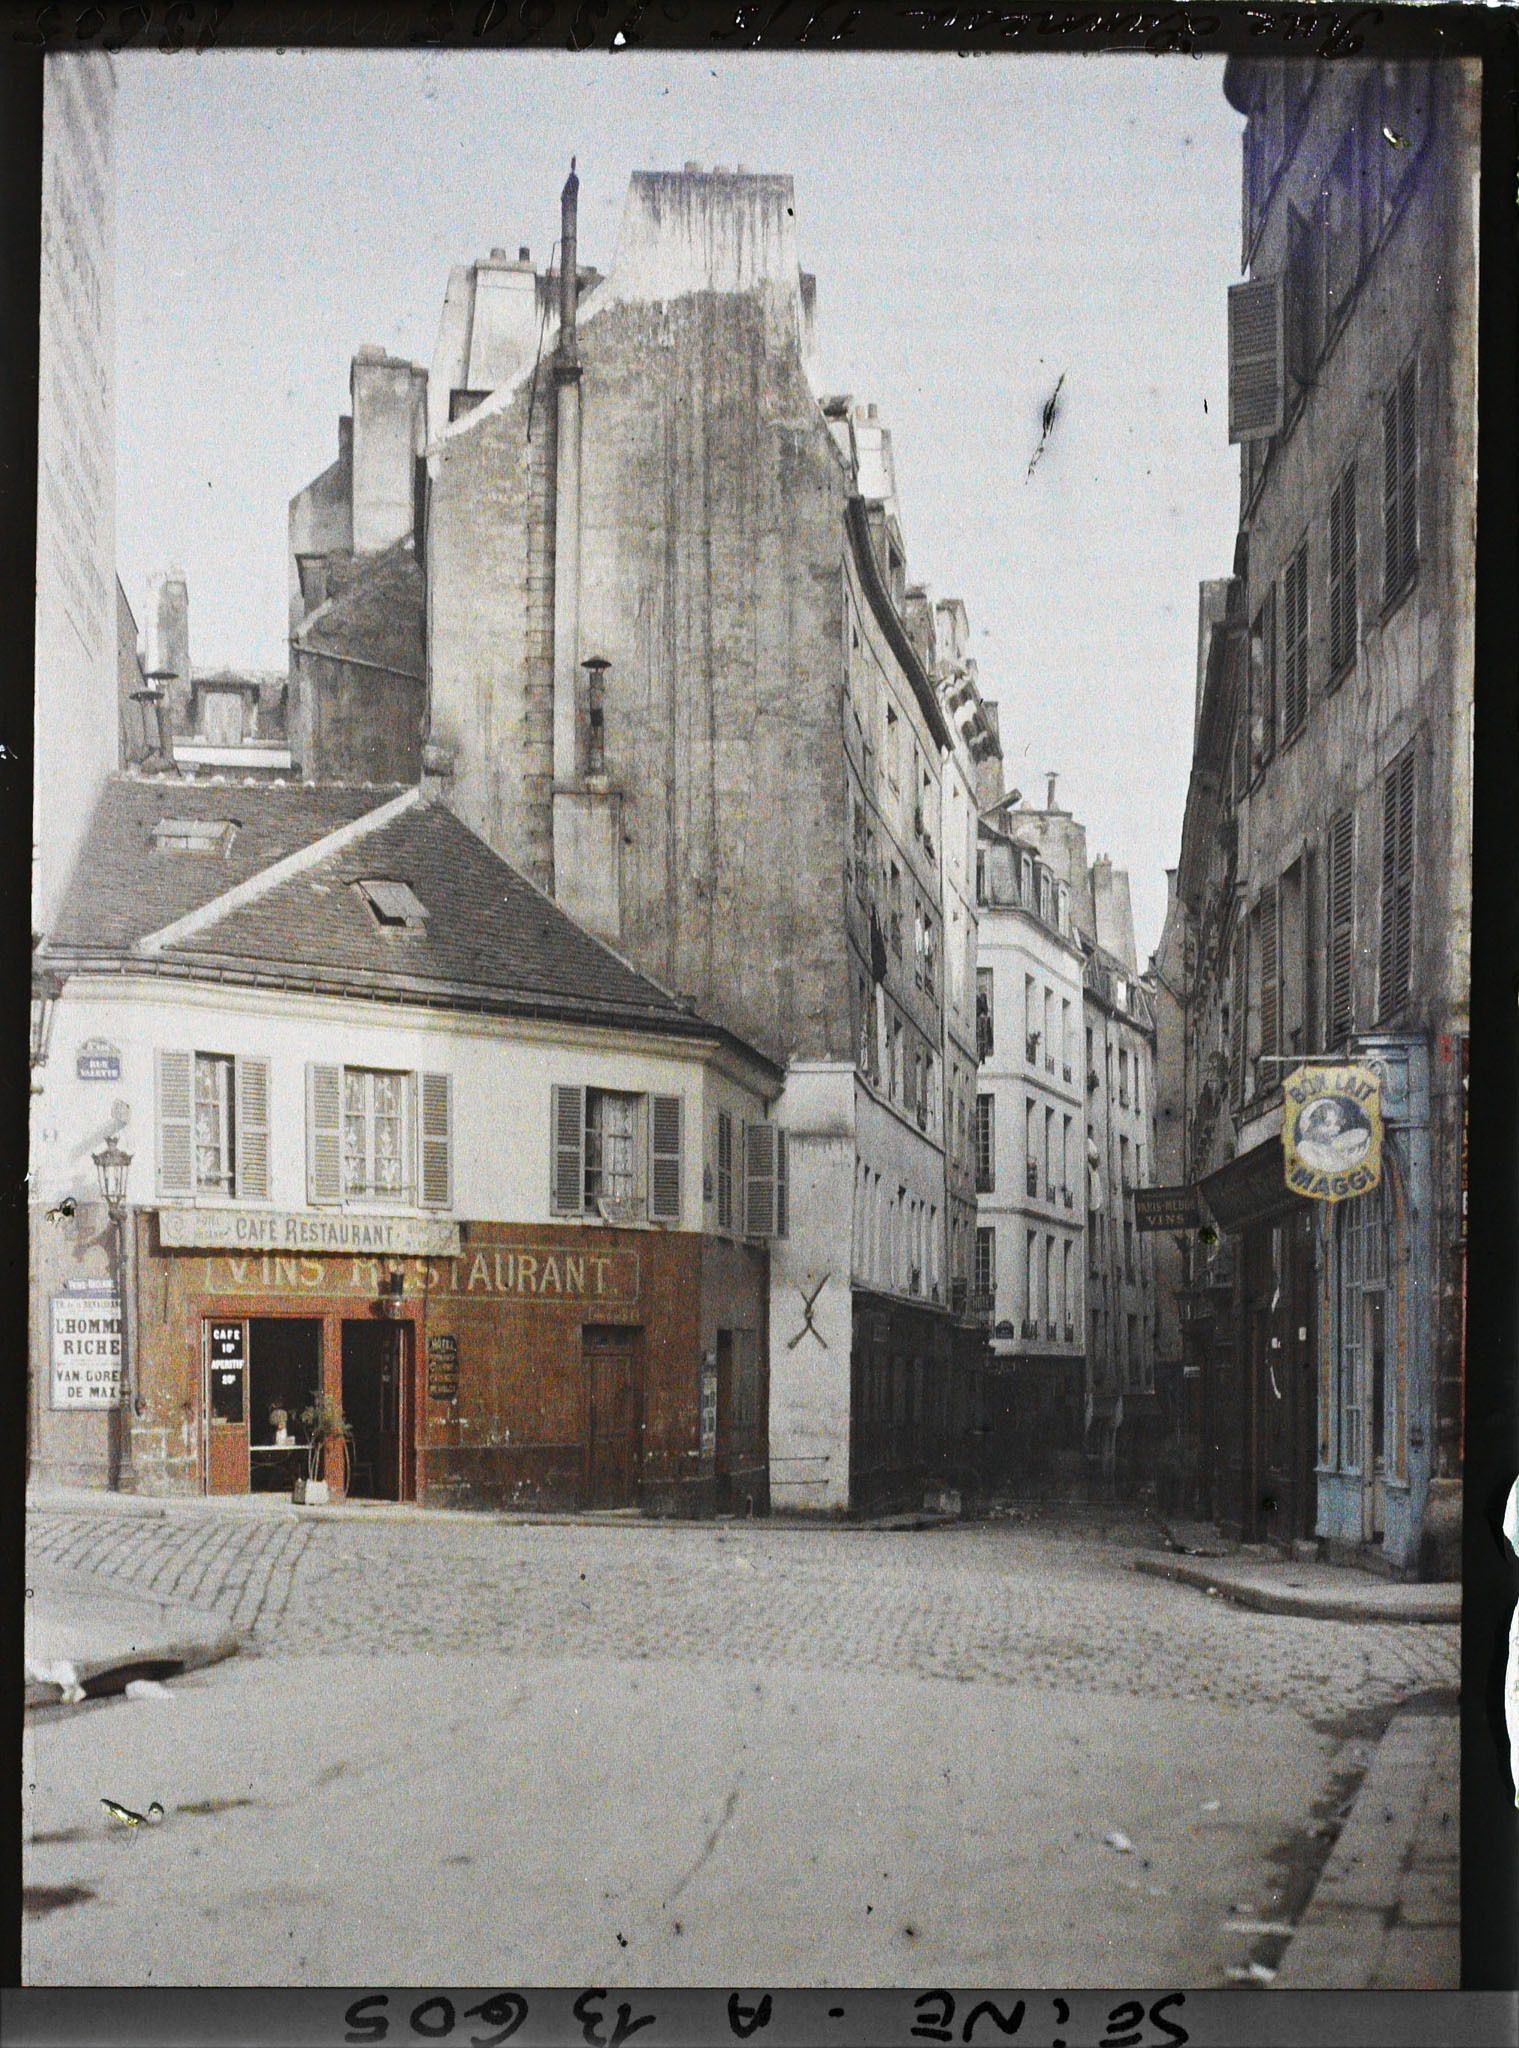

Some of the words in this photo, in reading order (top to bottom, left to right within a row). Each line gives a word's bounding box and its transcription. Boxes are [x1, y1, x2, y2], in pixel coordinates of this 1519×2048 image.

[1289, 1073, 1326, 1104] BON
[1335, 1073, 1377, 1101] LAIT
[1290, 1165, 1375, 1196] MAGGI
[285, 1218, 393, 1248] RESTAURANT
[1145, 1213, 1185, 1226] VINS
[229, 1256, 326, 1287] VINS
[63, 1340, 120, 1355] RICHE
[57, 1370, 80, 1381] VAN
[86, 1370, 121, 1381] DORE
[67, 1386, 83, 1398] DE
[89, 1386, 116, 1398] MAX
[573, 1988, 656, 2048] 13
[727, 1992, 773, 2039] A
